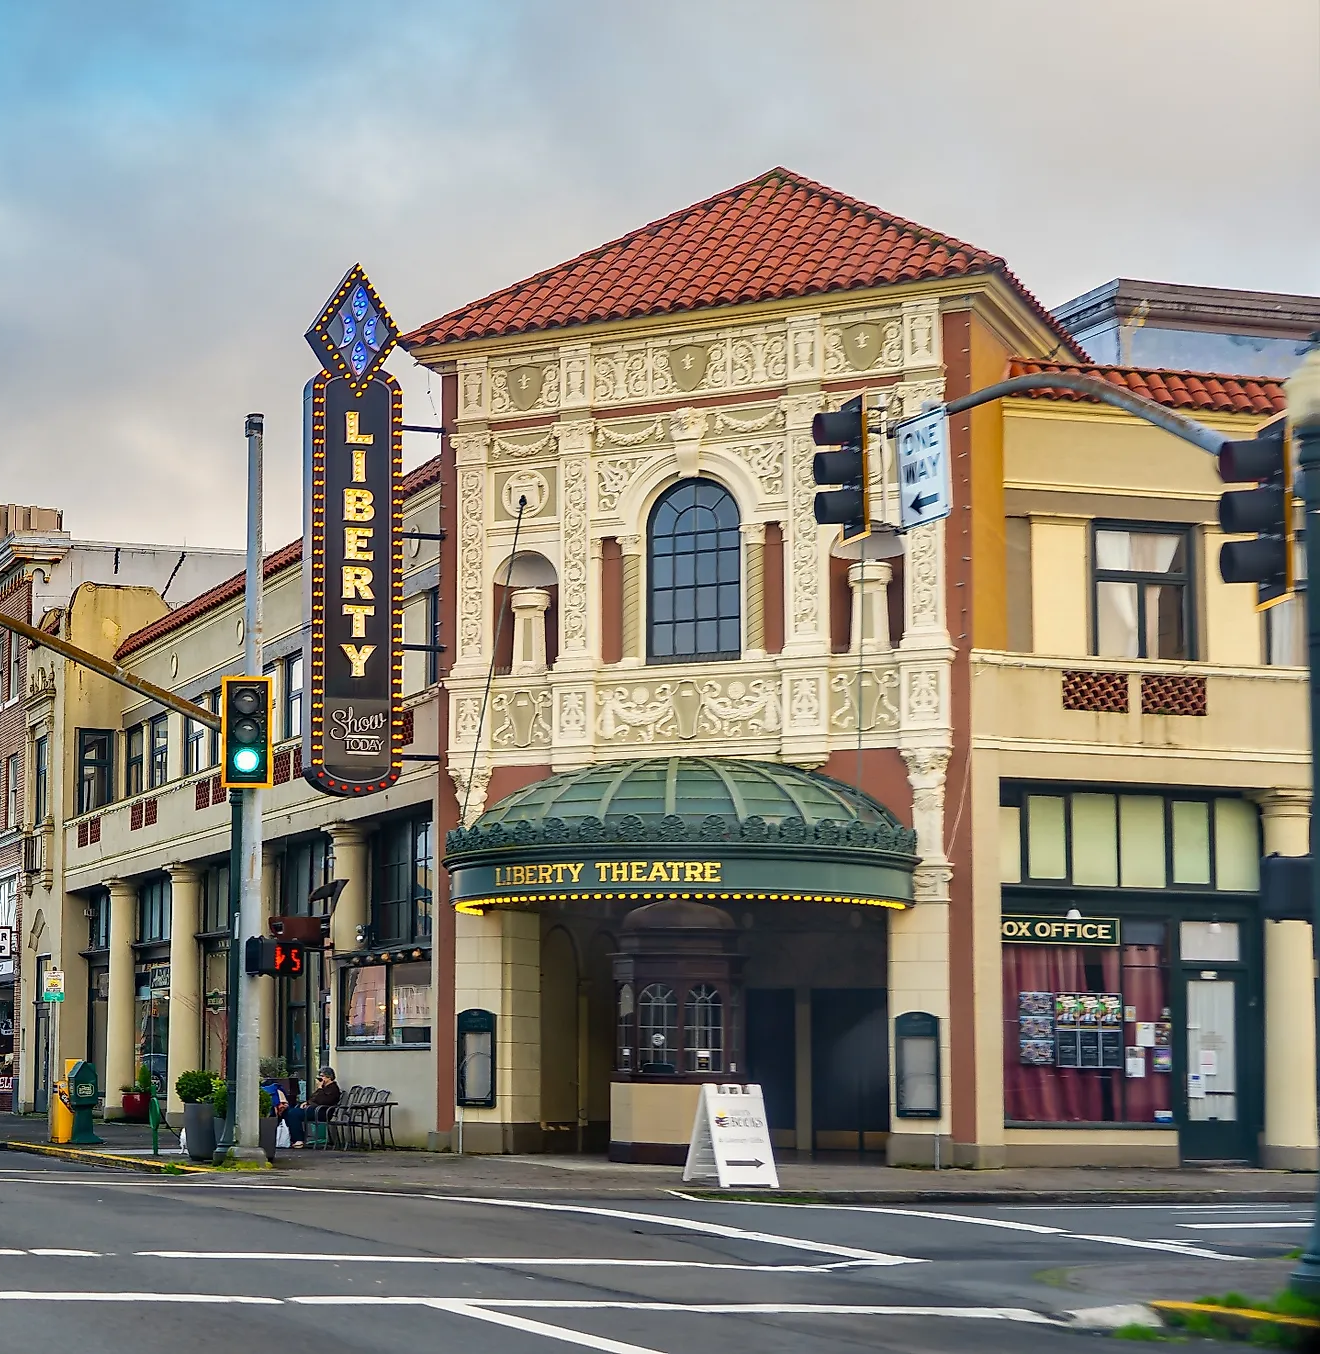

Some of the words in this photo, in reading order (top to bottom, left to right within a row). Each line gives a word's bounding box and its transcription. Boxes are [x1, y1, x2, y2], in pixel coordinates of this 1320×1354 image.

[903, 422, 939, 456] ONE
[902, 453, 941, 486] WAY
[340, 411, 377, 678] LIBERTY
[330, 706, 387, 740] Show
[345, 738, 384, 751] TODAY
[495, 862, 584, 886] LIBERTY
[595, 861, 722, 882] THEATRE
[1001, 920, 1032, 937] OX
[1034, 921, 1112, 939] OFFICE
[291, 949, 300, 970] 5
